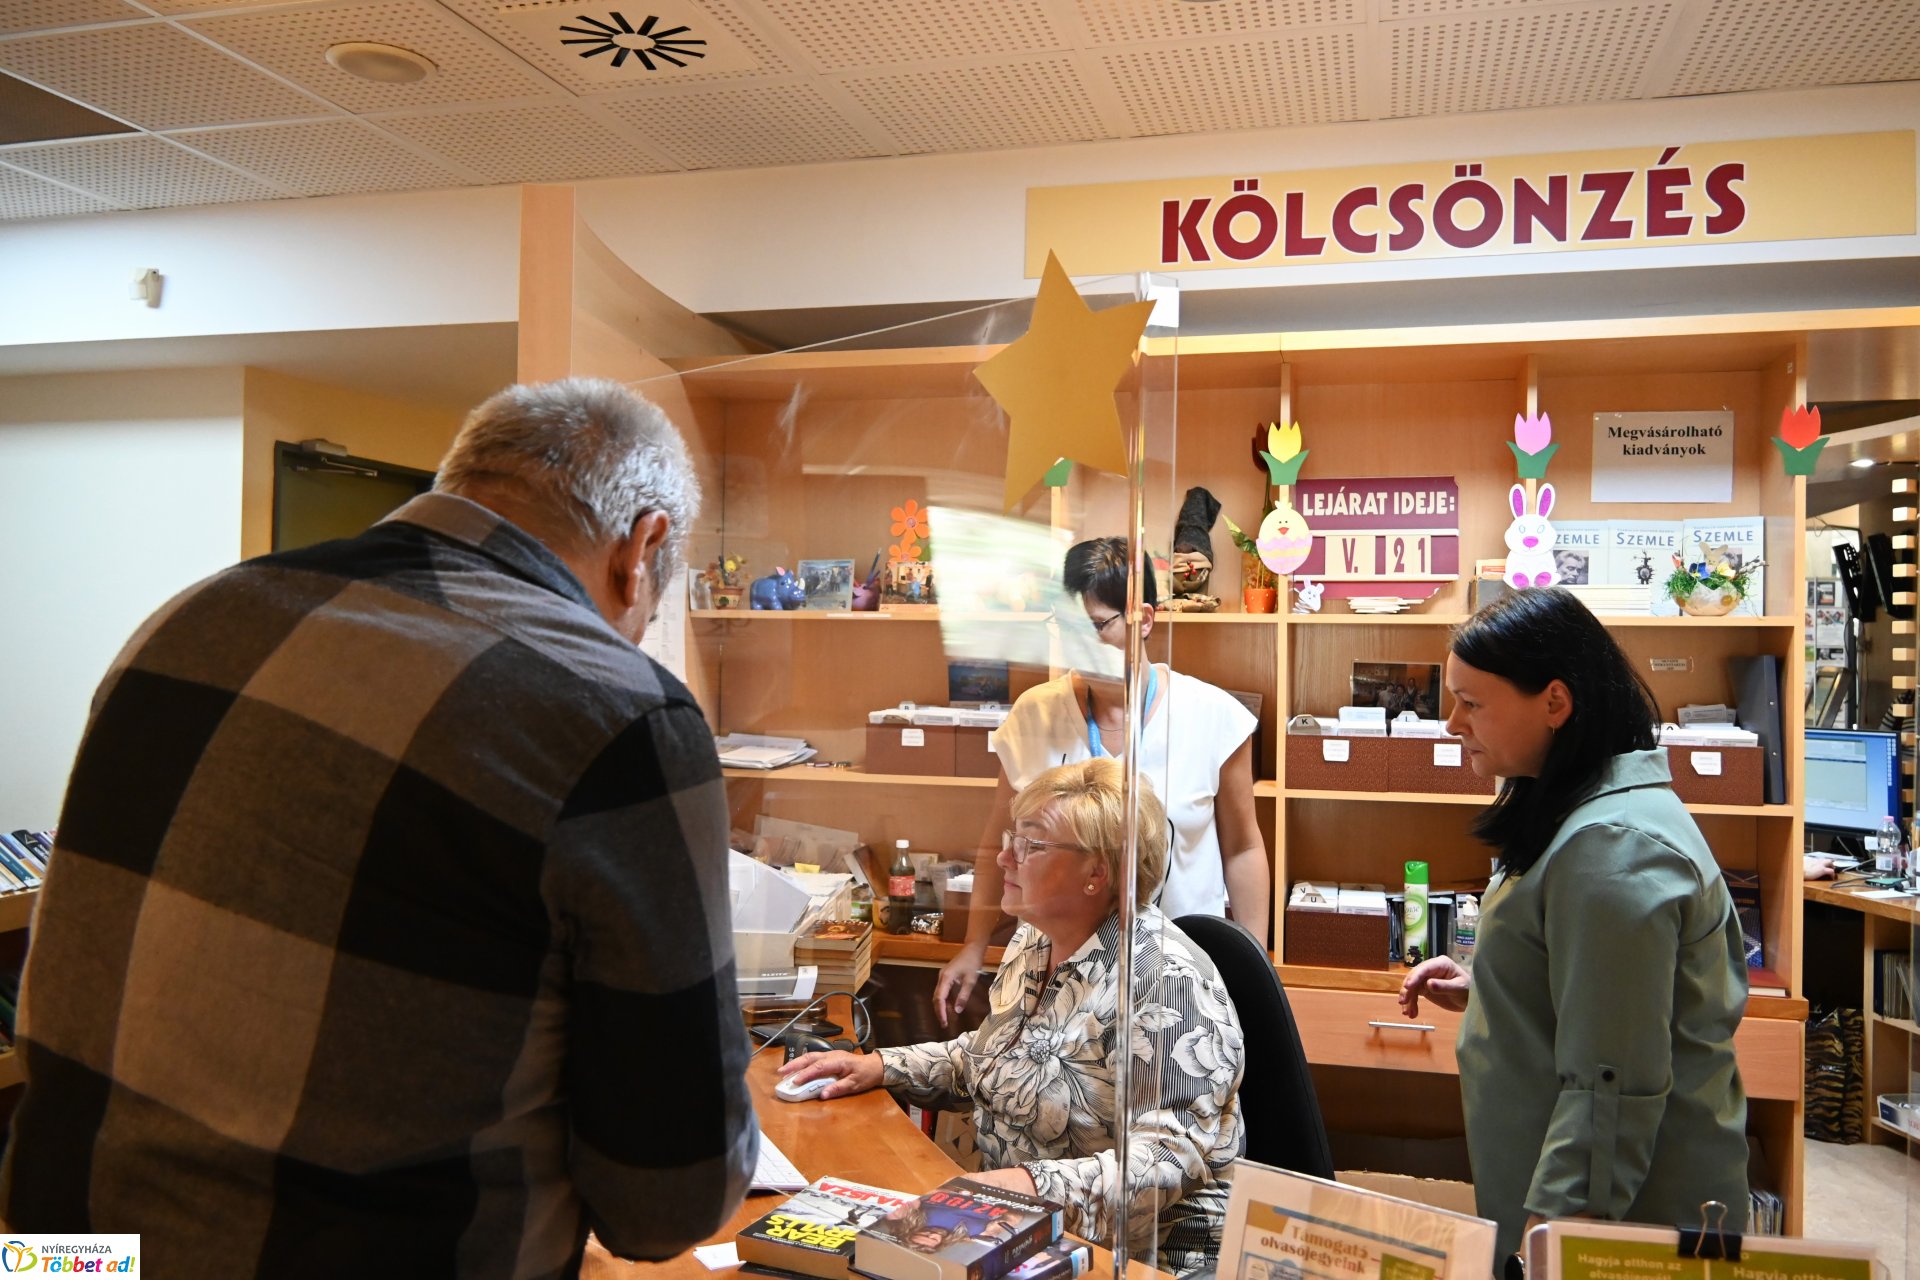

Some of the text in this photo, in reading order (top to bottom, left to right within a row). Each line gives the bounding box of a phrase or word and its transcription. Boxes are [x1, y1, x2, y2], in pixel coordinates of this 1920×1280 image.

[1161, 146, 1746, 264] KÖLCSÖNZÉS
[1607, 425, 1723, 441] Megvásárolható
[1622, 443, 1707, 458] kiadványok
[1302, 485, 1455, 516] LEJÁRAT IDEJE:
[1554, 532, 1600, 545] ZEMLE
[1342, 537, 1358, 574] V.
[1301, 718, 1309, 726] K
[766, 1225, 849, 1249] BEAR
